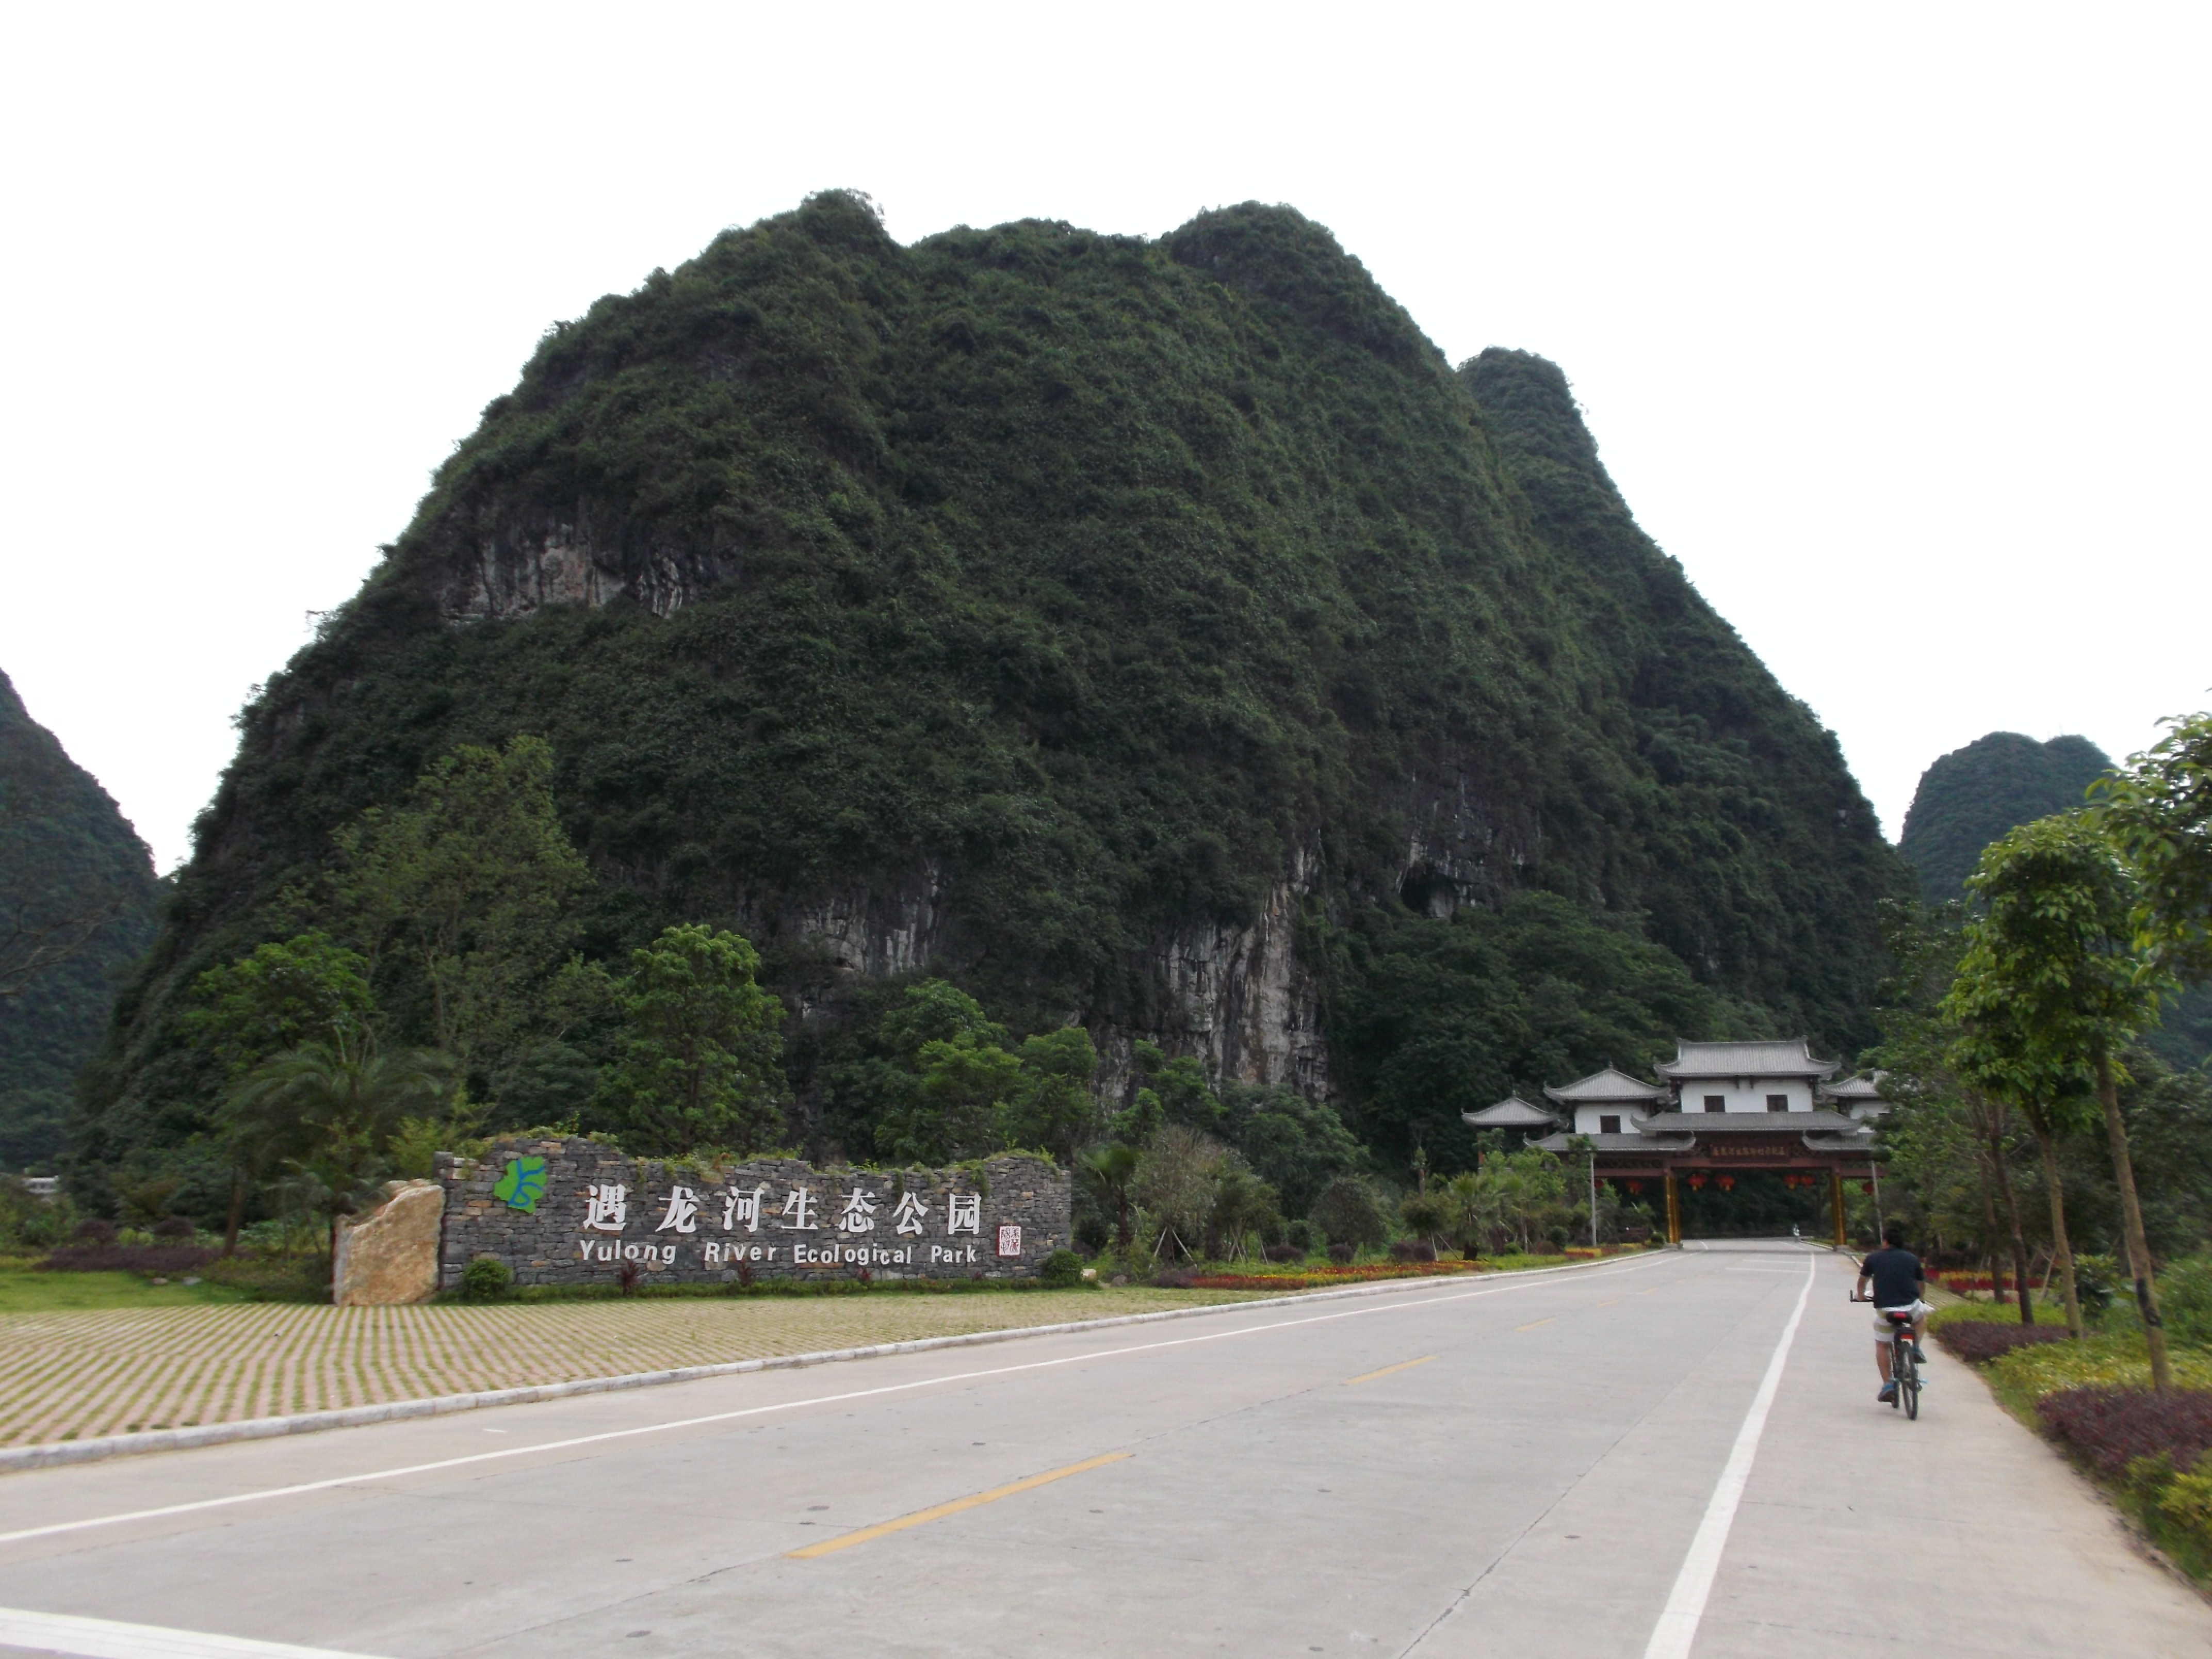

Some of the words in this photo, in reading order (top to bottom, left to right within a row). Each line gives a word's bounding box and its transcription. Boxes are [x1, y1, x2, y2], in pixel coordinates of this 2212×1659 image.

[582, 1184, 982, 1234] 遇龙河生态公园
[579, 1240, 676, 1264] Yulong
[704, 1242, 777, 1262] River
[793, 1243, 912, 1265] Ecological
[930, 1245, 977, 1263] Park
